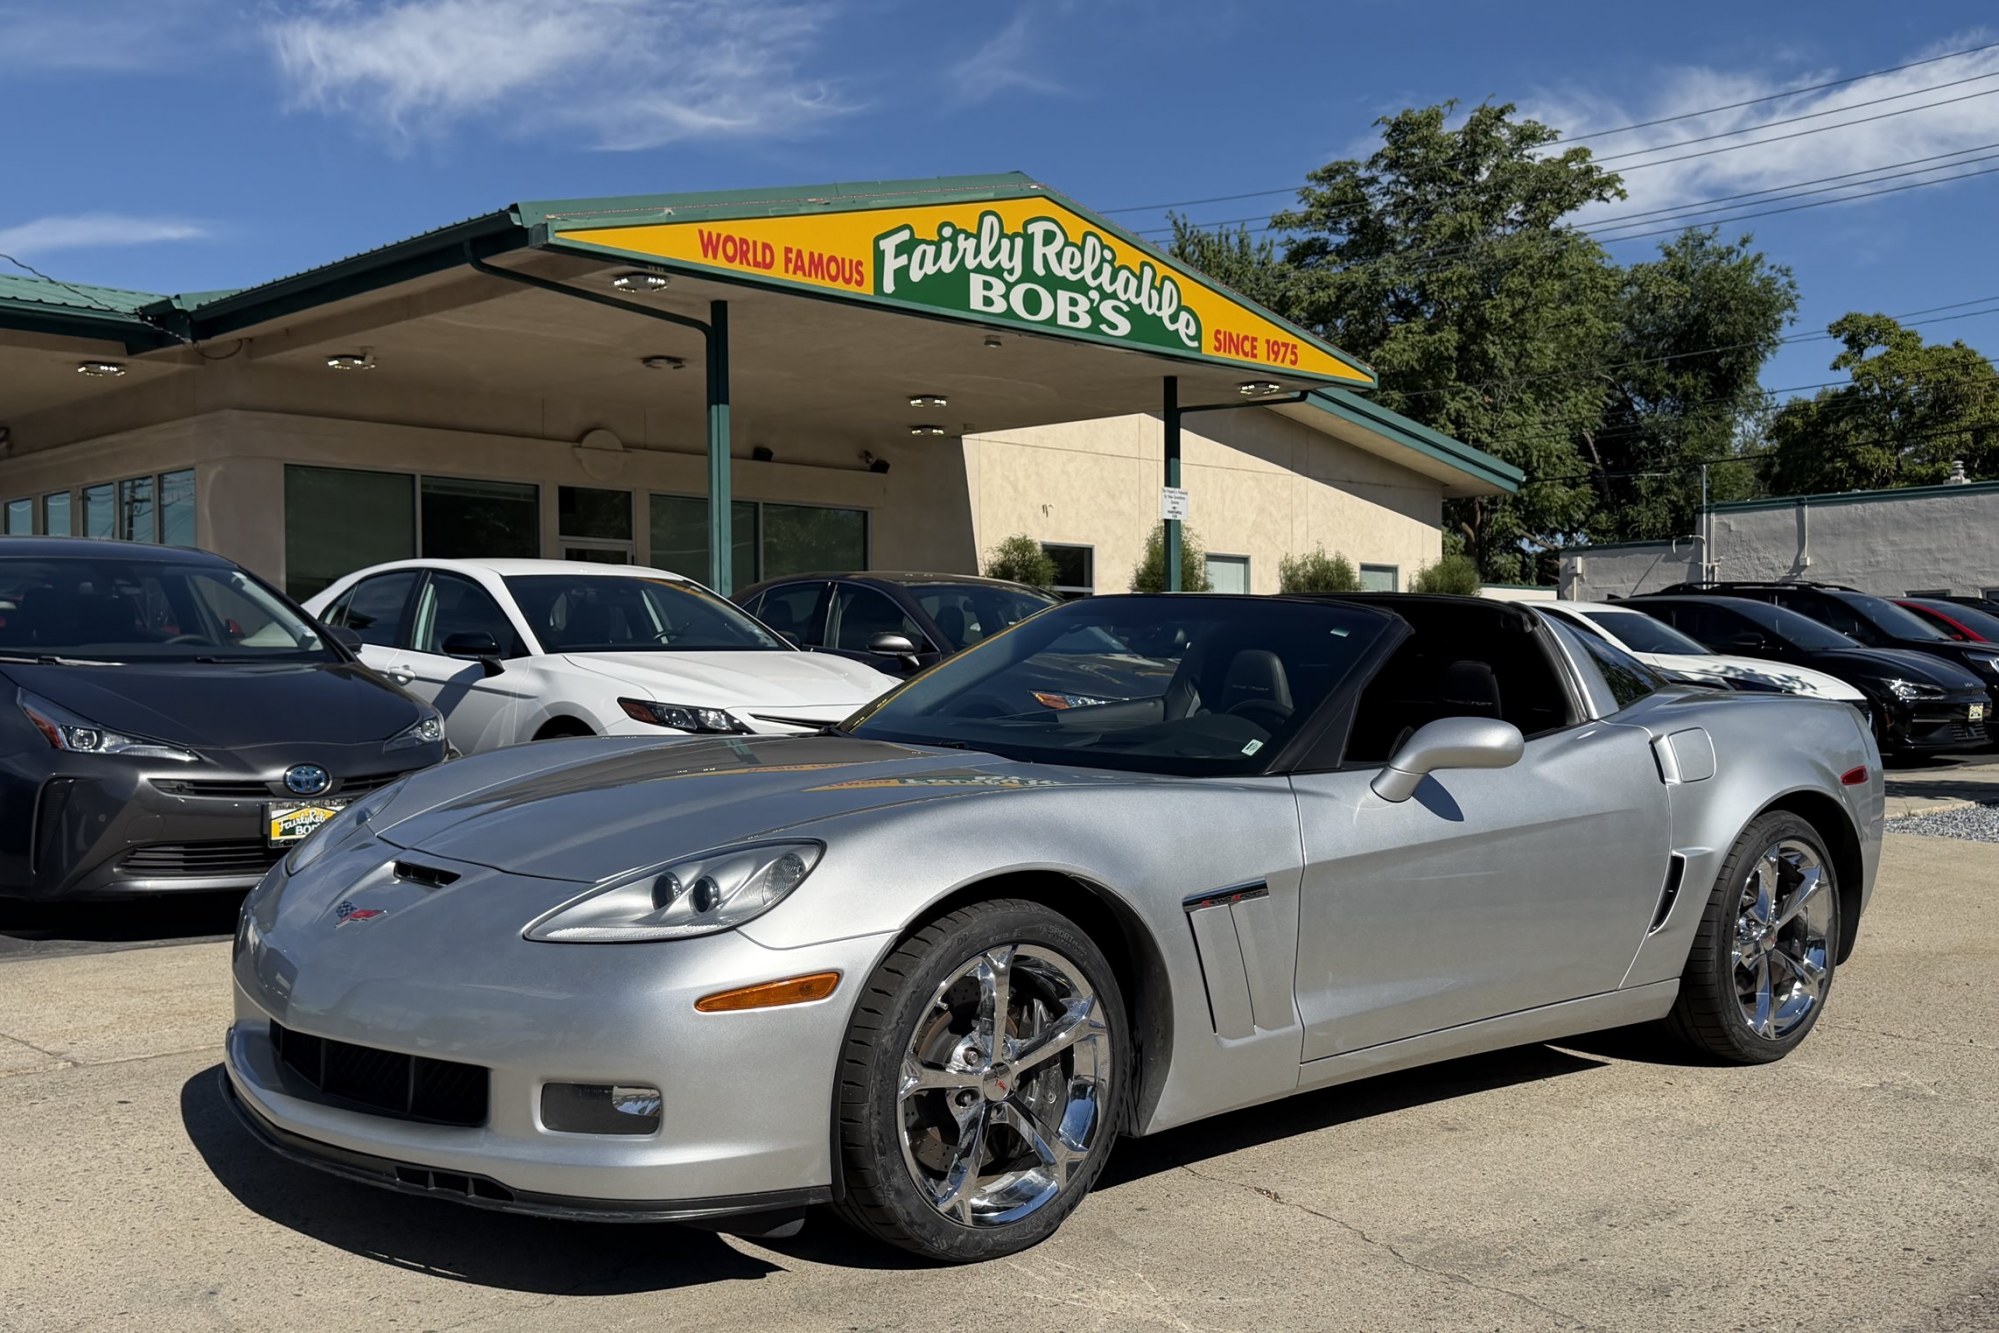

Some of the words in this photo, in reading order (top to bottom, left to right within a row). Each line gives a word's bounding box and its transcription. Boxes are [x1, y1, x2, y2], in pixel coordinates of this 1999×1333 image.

[698, 229, 775, 270] WORLD
[784, 246, 864, 287] FAMOUS
[879, 215, 1023, 294] Fairly
[1027, 221, 1199, 348] Reliable
[969, 272, 1132, 337] BOB'S
[1213, 329, 1258, 359] SINCE
[1265, 339, 1299, 366] 1975
